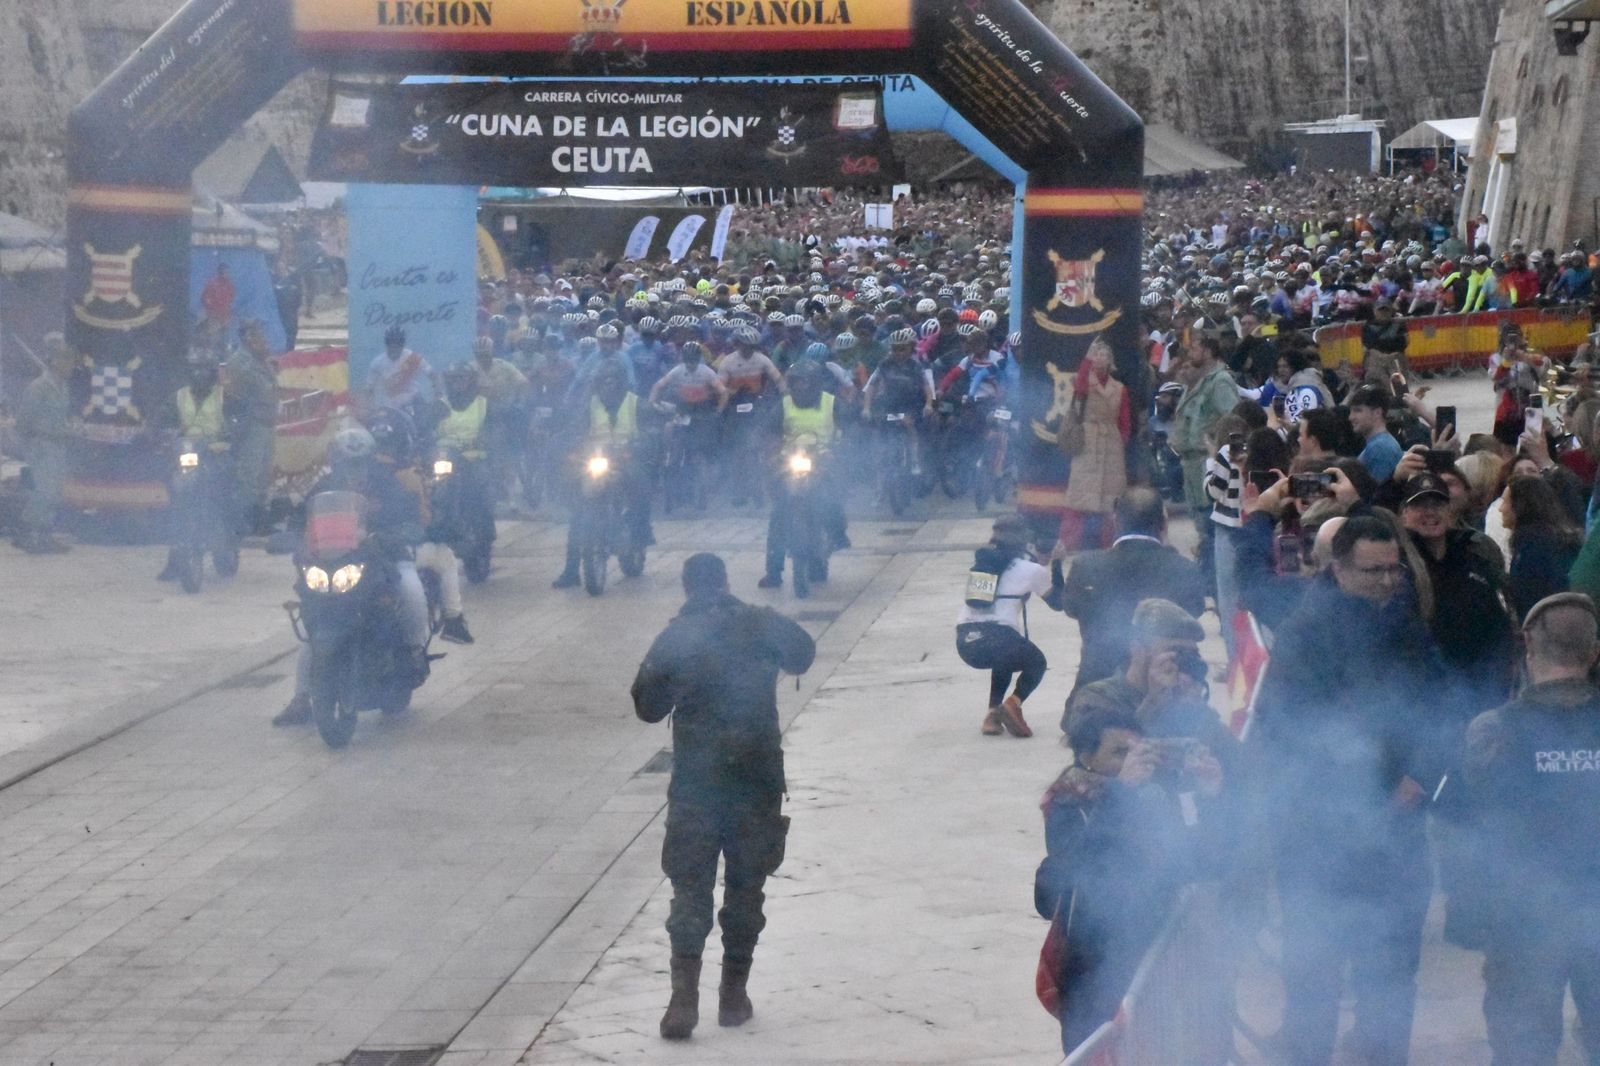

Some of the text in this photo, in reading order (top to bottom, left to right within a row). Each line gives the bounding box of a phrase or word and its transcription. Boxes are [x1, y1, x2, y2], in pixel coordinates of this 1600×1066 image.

[524, 89, 683, 105] CARRERA CÍVICO-MILITAR
[553, 115, 587, 137] DE
[596, 116, 630, 137] LA
[551, 146, 654, 173] CEUTA
[363, 301, 460, 327] Deporte
